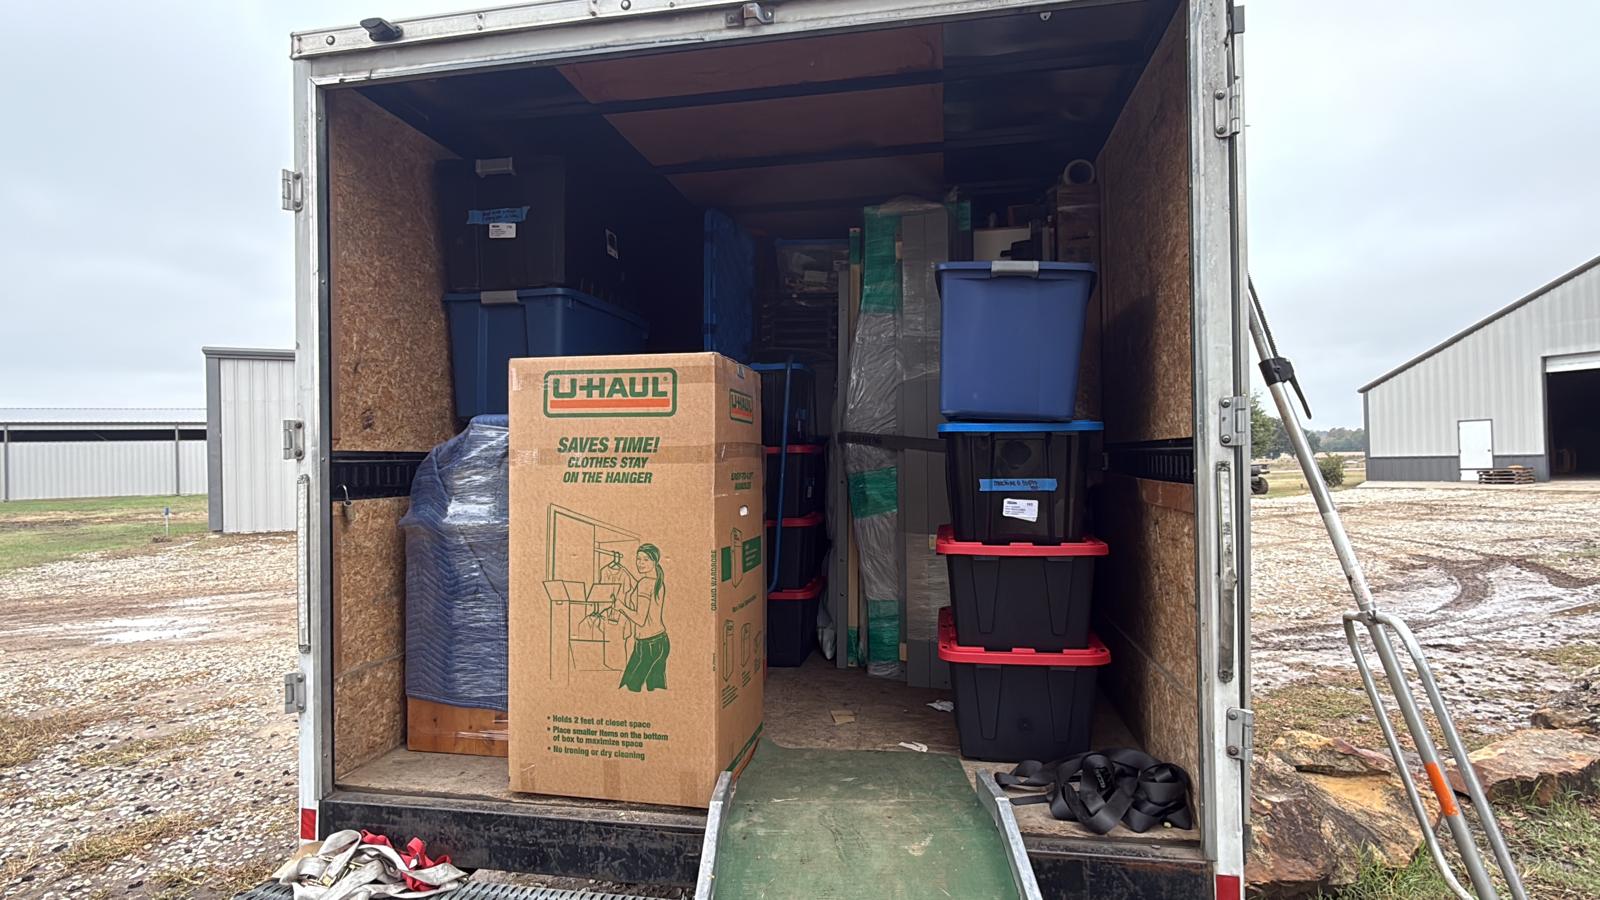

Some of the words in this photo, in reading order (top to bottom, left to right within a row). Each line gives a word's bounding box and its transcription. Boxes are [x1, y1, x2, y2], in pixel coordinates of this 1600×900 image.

[557, 436, 610, 454] SAVES
[614, 436, 660, 454] TIME!
[567, 456, 618, 469] CLOTHES
[620, 456, 649, 469] STAY
[563, 471, 579, 484] ON
[581, 471, 603, 484] THE
[604, 471, 654, 484] HANGER
[553, 715, 572, 723] Holds
[574, 716, 579, 724] 2
[580, 716, 595, 726] feet
[596, 718, 604, 726] of
[605, 718, 627, 727] closet
[629, 721, 651, 729] space
[553, 726, 571, 734] Place
[573, 728, 597, 736] smaller
[599, 730, 619, 738] items
[630, 731, 641, 739] the
[643, 732, 668, 740] bottom
[576, 736, 584, 744] to
[585, 737, 620, 745] maximize
[622, 740, 643, 748] space
[553, 745, 563, 753] No
[564, 745, 589, 757] ironing
[600, 748, 612, 759] dry
[614, 749, 645, 760] cleaning
